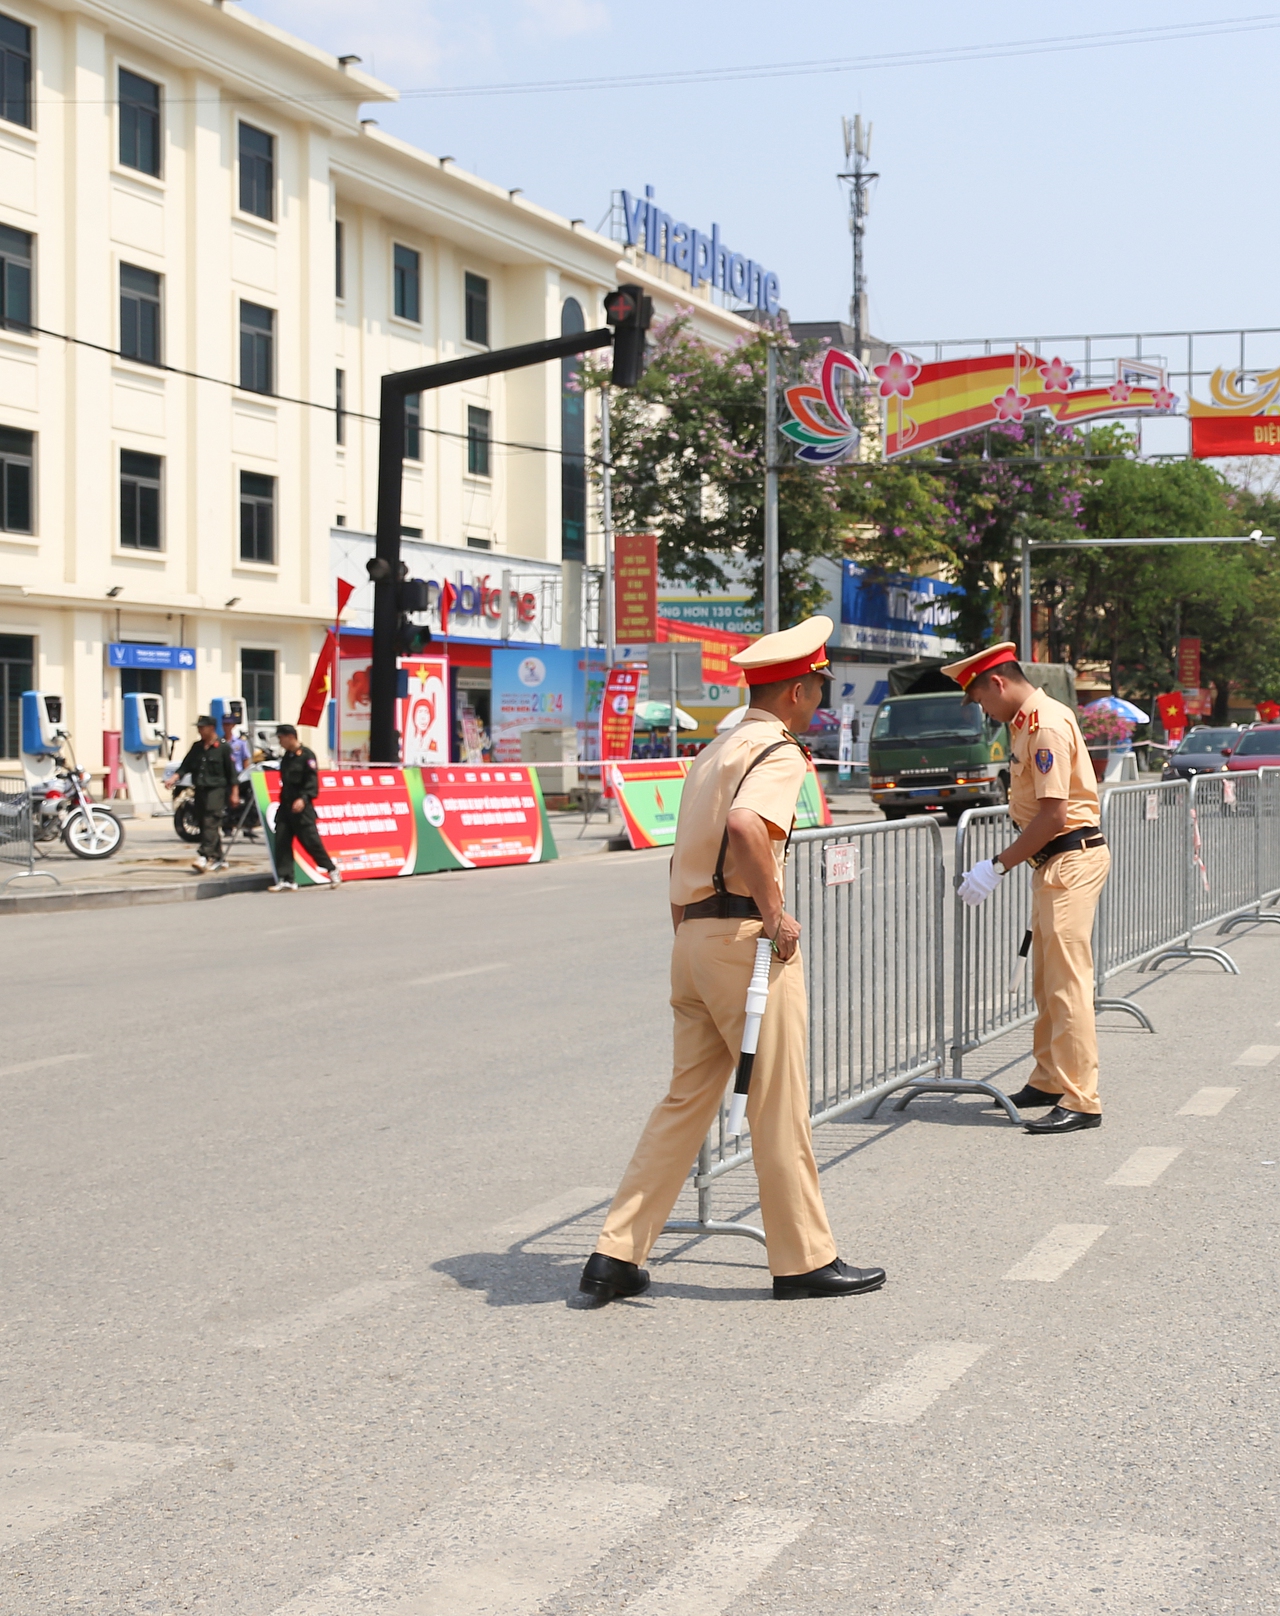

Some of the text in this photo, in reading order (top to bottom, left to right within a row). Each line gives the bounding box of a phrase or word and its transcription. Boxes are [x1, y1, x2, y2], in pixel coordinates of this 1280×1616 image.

[621, 184, 780, 316] vinaphone
[657, 603, 681, 617] ỐNG
[712, 606, 732, 617] 130
[532, 692, 563, 713] 2024
[900, 766, 949, 775] MITSUBISHI
